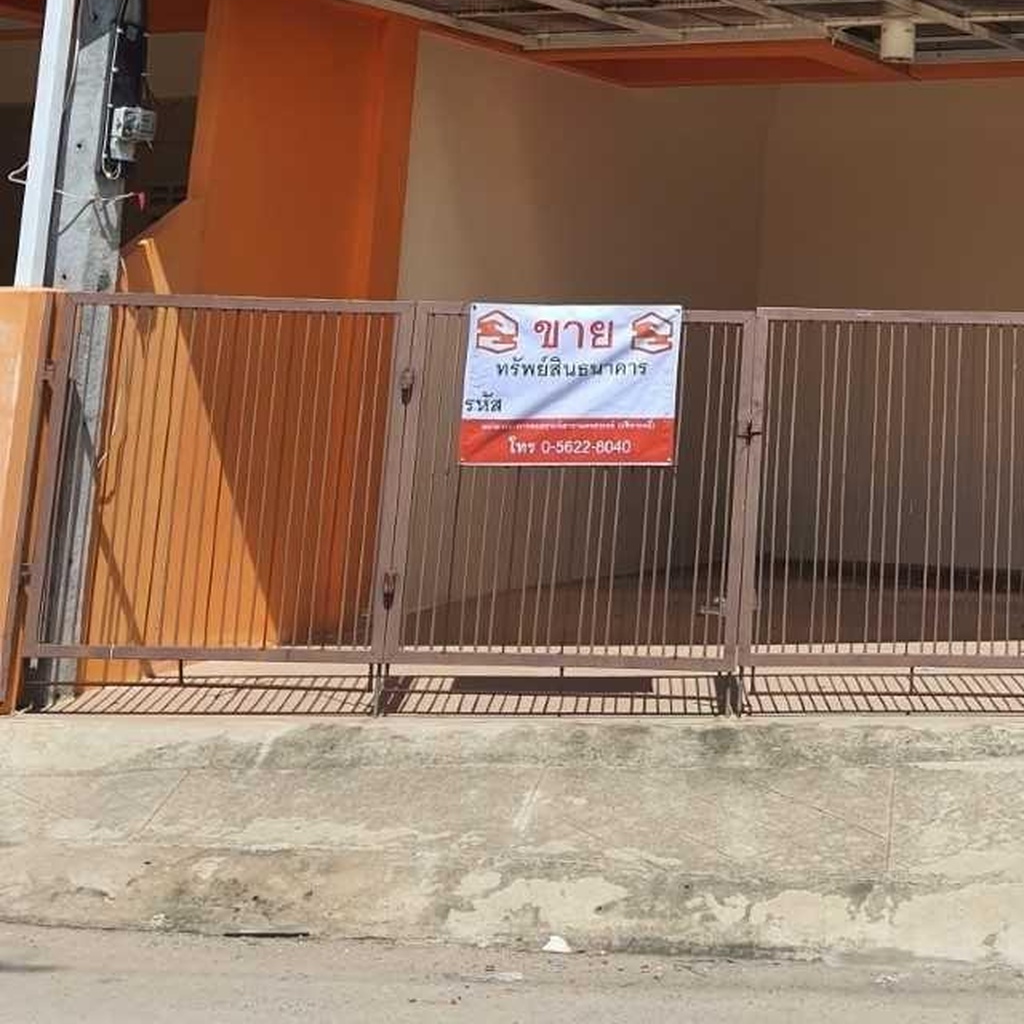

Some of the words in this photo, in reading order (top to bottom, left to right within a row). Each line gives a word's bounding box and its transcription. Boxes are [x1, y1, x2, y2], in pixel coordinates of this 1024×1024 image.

[533, 319, 614, 349] ขาย
[496, 355, 649, 377] ทรัพย์สินธนาคาร
[464, 391, 502, 412] รหัส
[541, 439, 632, 454] 0-5622-8040
